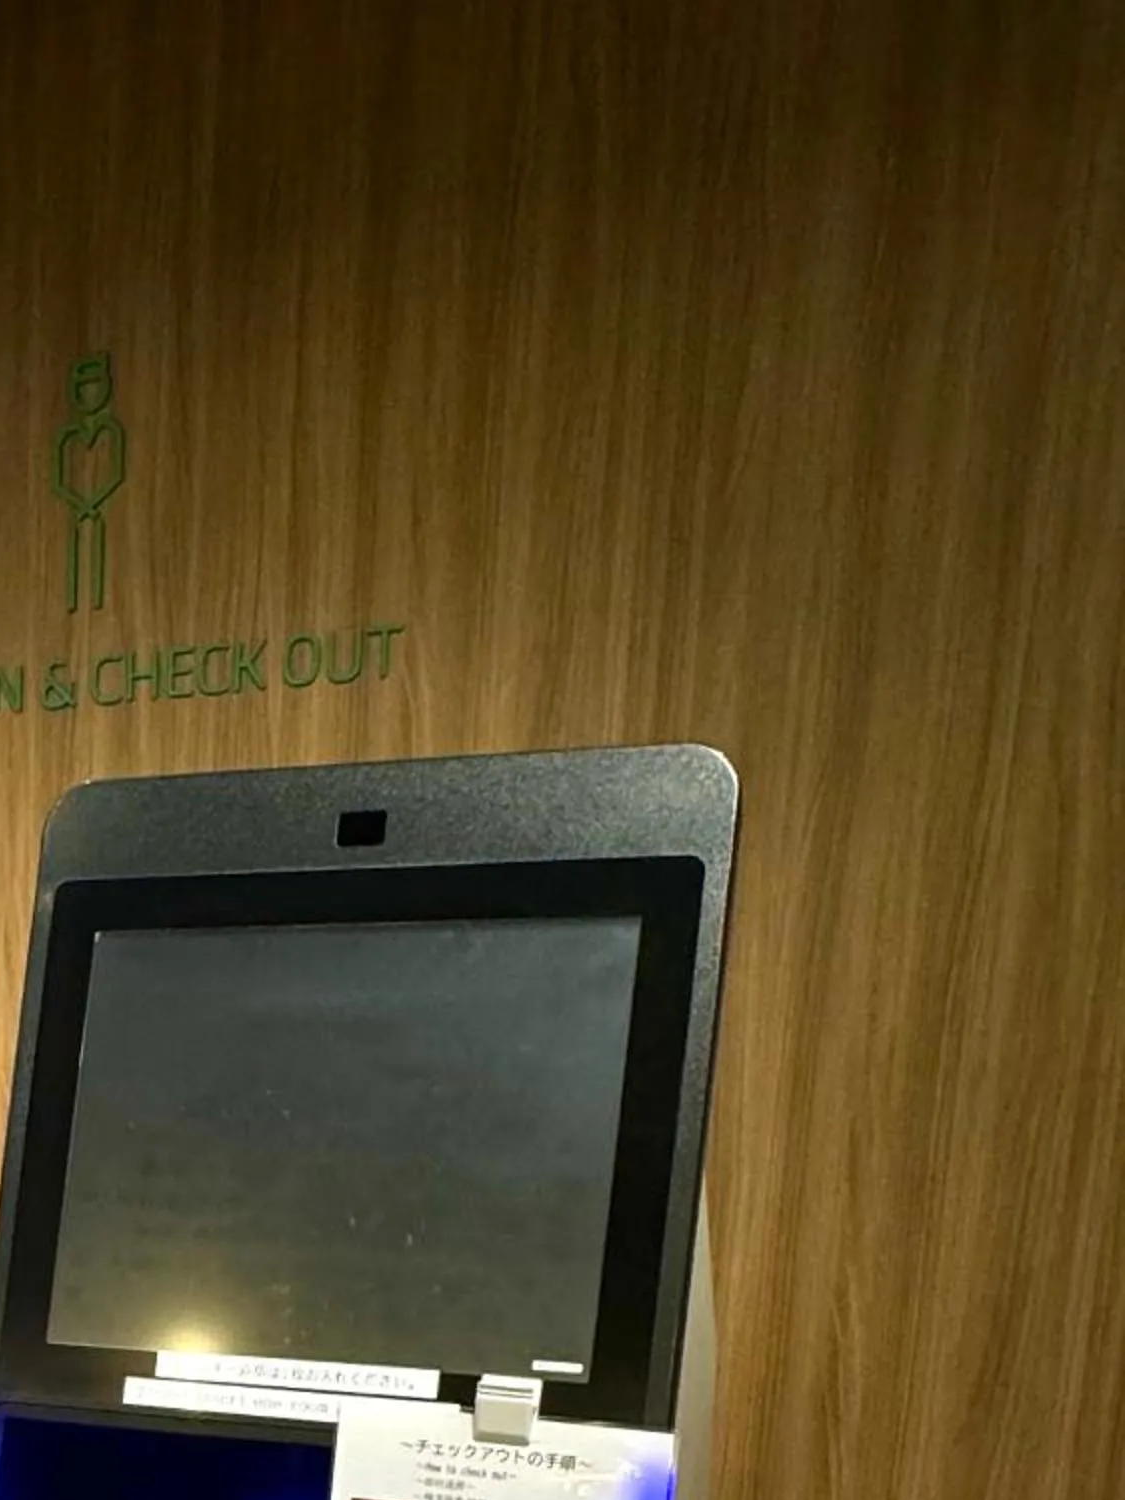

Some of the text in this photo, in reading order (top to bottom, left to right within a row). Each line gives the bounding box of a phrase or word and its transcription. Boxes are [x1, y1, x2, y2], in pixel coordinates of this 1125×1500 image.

[42, 661, 77, 711] &
[90, 640, 266, 706] CHECK
[281, 624, 405, 690] OUT
